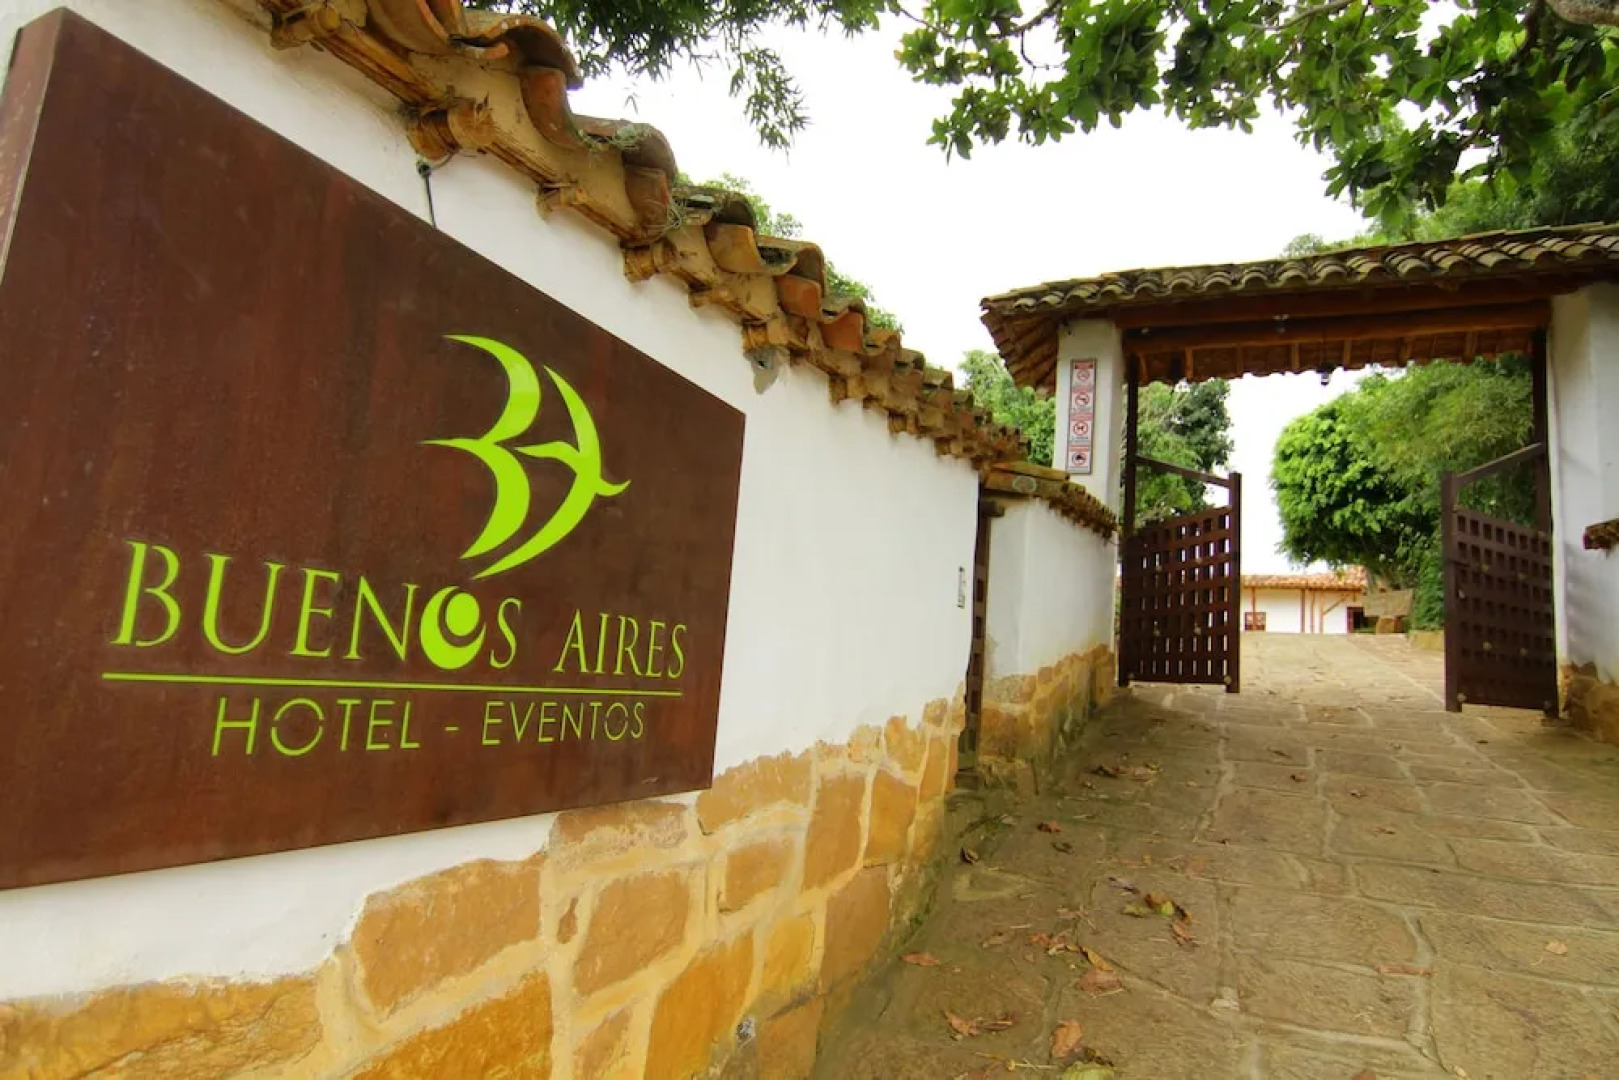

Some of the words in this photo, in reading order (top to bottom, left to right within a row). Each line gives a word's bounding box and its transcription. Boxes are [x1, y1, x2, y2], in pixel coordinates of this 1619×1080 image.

[110, 540, 522, 670] BUENOS
[554, 609, 687, 679] AIRES
[210, 696, 421, 757] HOTEL
[482, 700, 646, 747] EVENTOS
